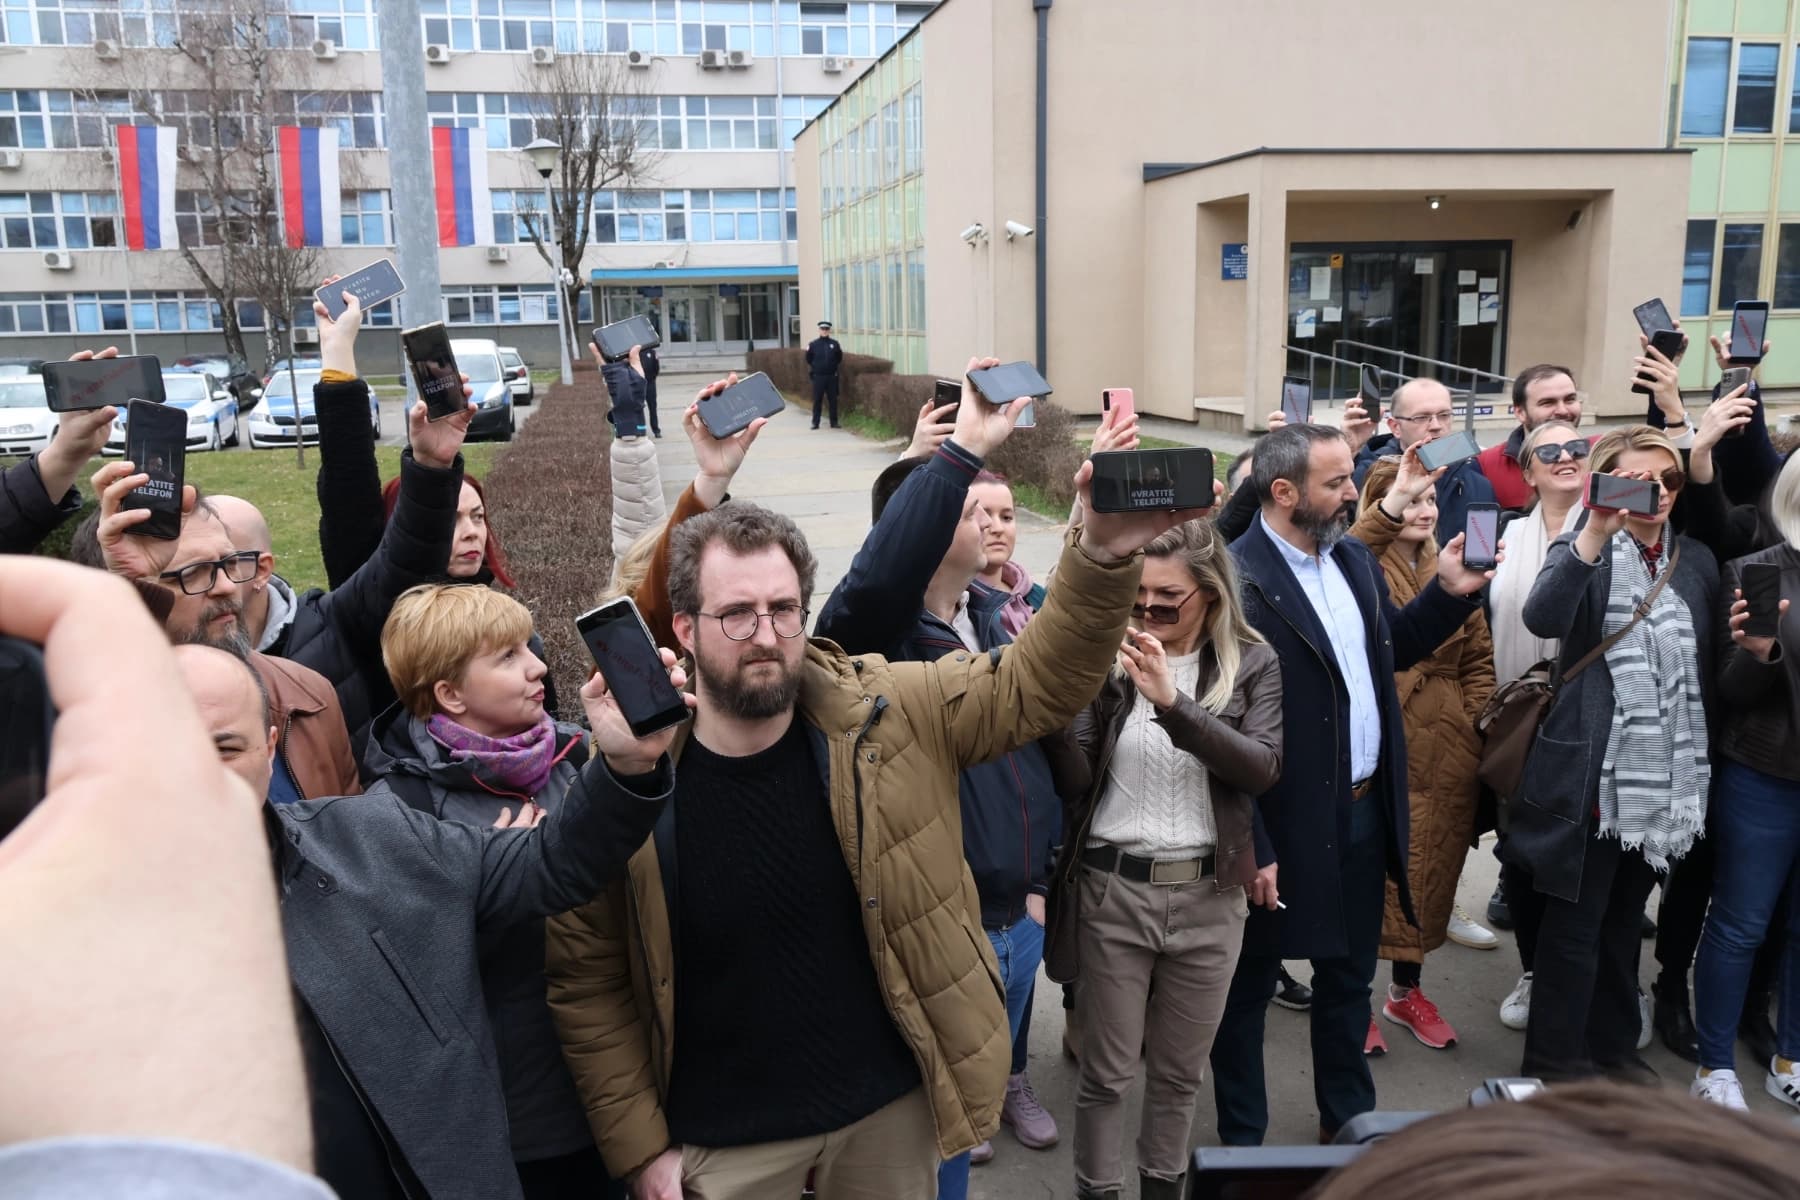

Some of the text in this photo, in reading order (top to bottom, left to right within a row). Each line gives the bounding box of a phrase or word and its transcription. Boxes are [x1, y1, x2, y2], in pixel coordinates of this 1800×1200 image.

[425, 382, 455, 394] TELEFON
[146, 480, 175, 490] ATITE
[1131, 489, 1175, 498] #VRATITE
[1133, 498, 1174, 506] TELEFON
